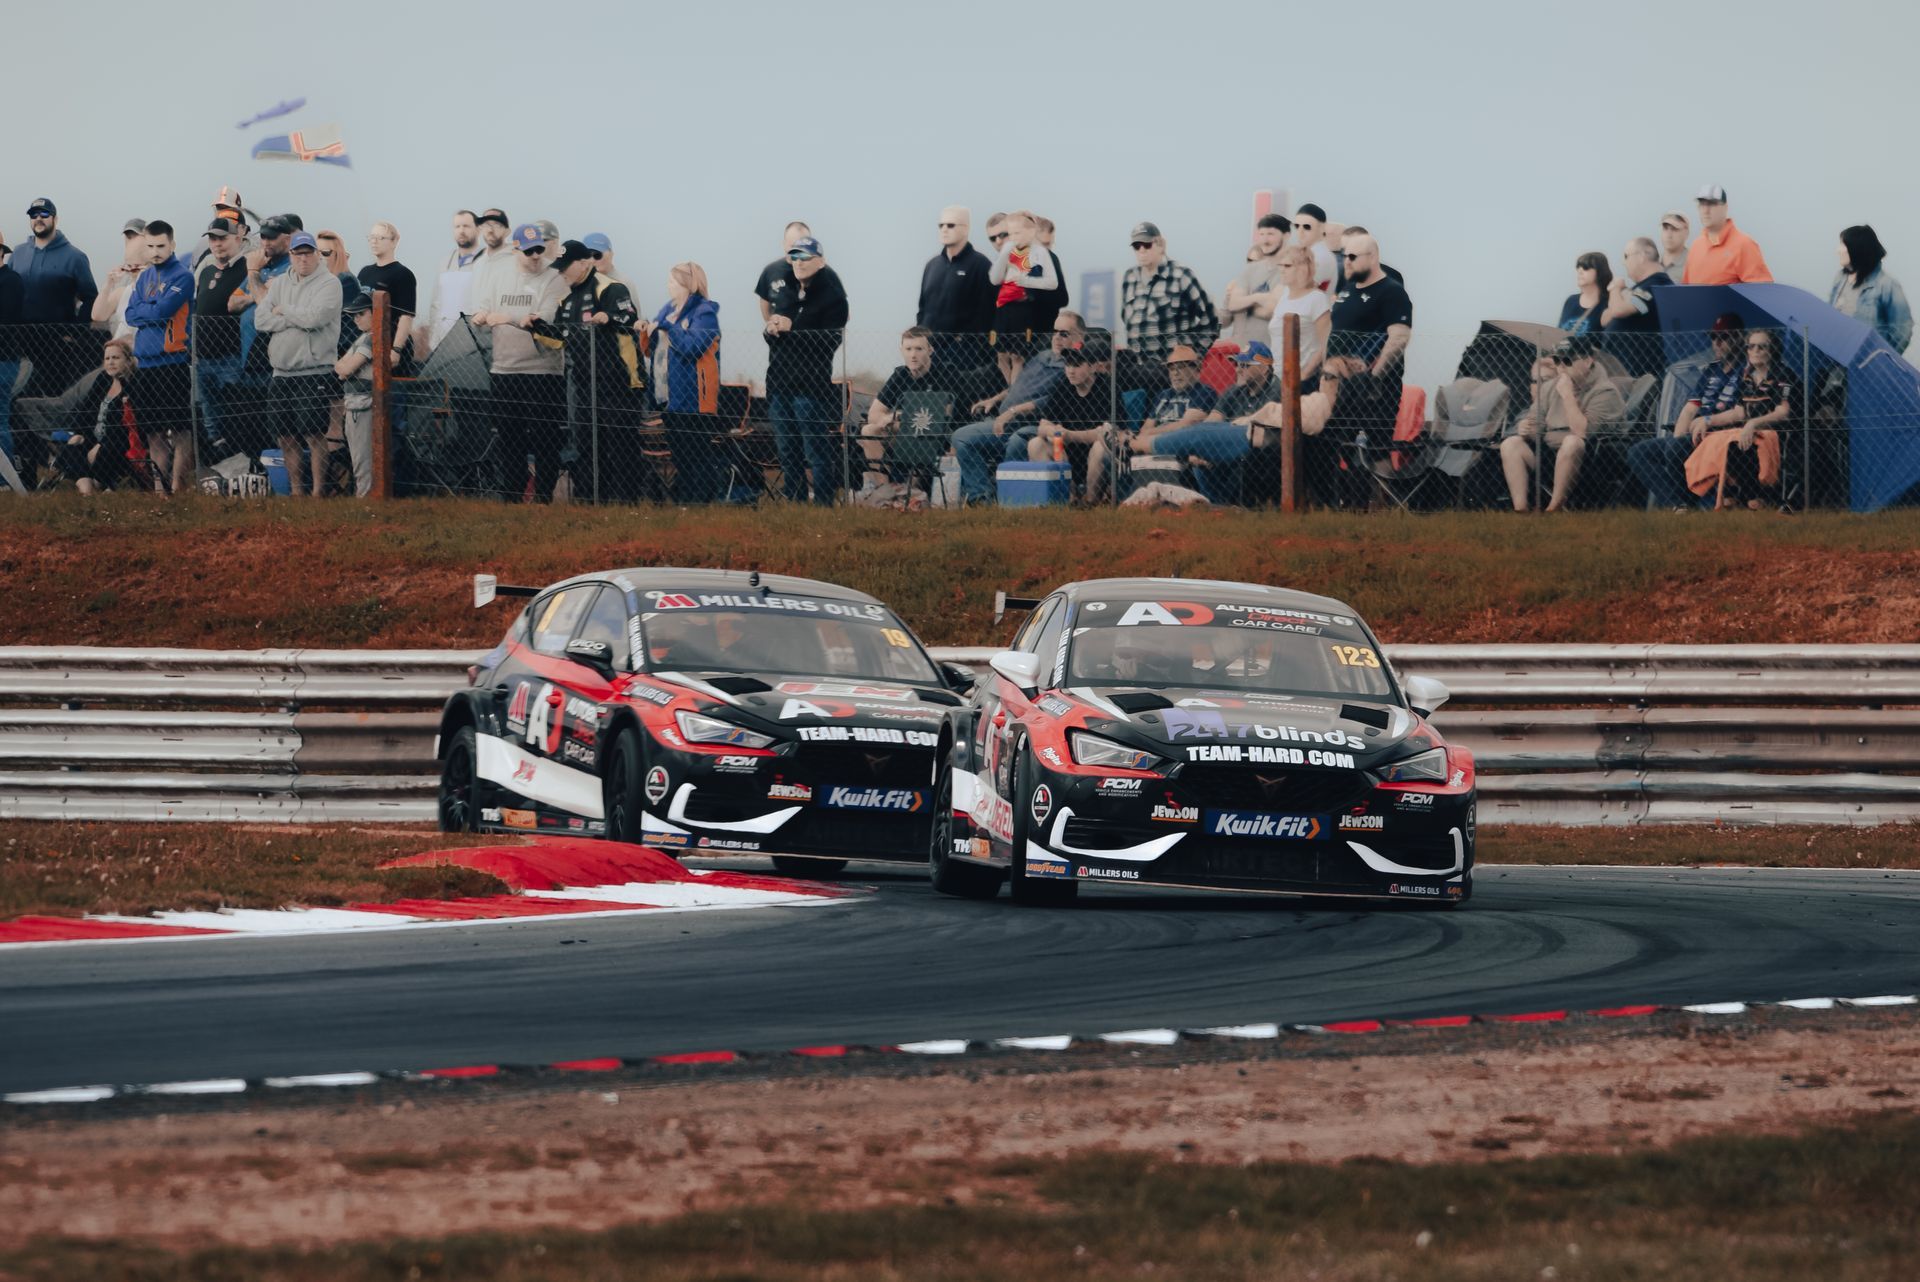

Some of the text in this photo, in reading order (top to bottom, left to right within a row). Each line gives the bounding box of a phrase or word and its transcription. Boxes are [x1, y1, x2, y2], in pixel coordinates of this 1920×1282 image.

[501, 294, 533, 306] PUMA
[699, 594, 884, 621] MILLERS OILS
[1116, 601, 1214, 626] AD
[1215, 603, 1332, 623] AUTOBRITE
[1232, 618, 1317, 634] CAR CARE
[880, 627, 911, 648] 19
[1331, 645, 1380, 668] 123
[779, 699, 857, 720] AD
[1186, 745, 1355, 769] TEAM-HARD.COM
[1103, 778, 1142, 789] PCM
[1401, 793, 1434, 805] PCM
[1151, 805, 1199, 820] JEWSON
[1339, 814, 1383, 828] JEWSON
[1088, 868, 1139, 879] MILLERS OILS
[1400, 885, 1440, 895] MILLERS OILS
